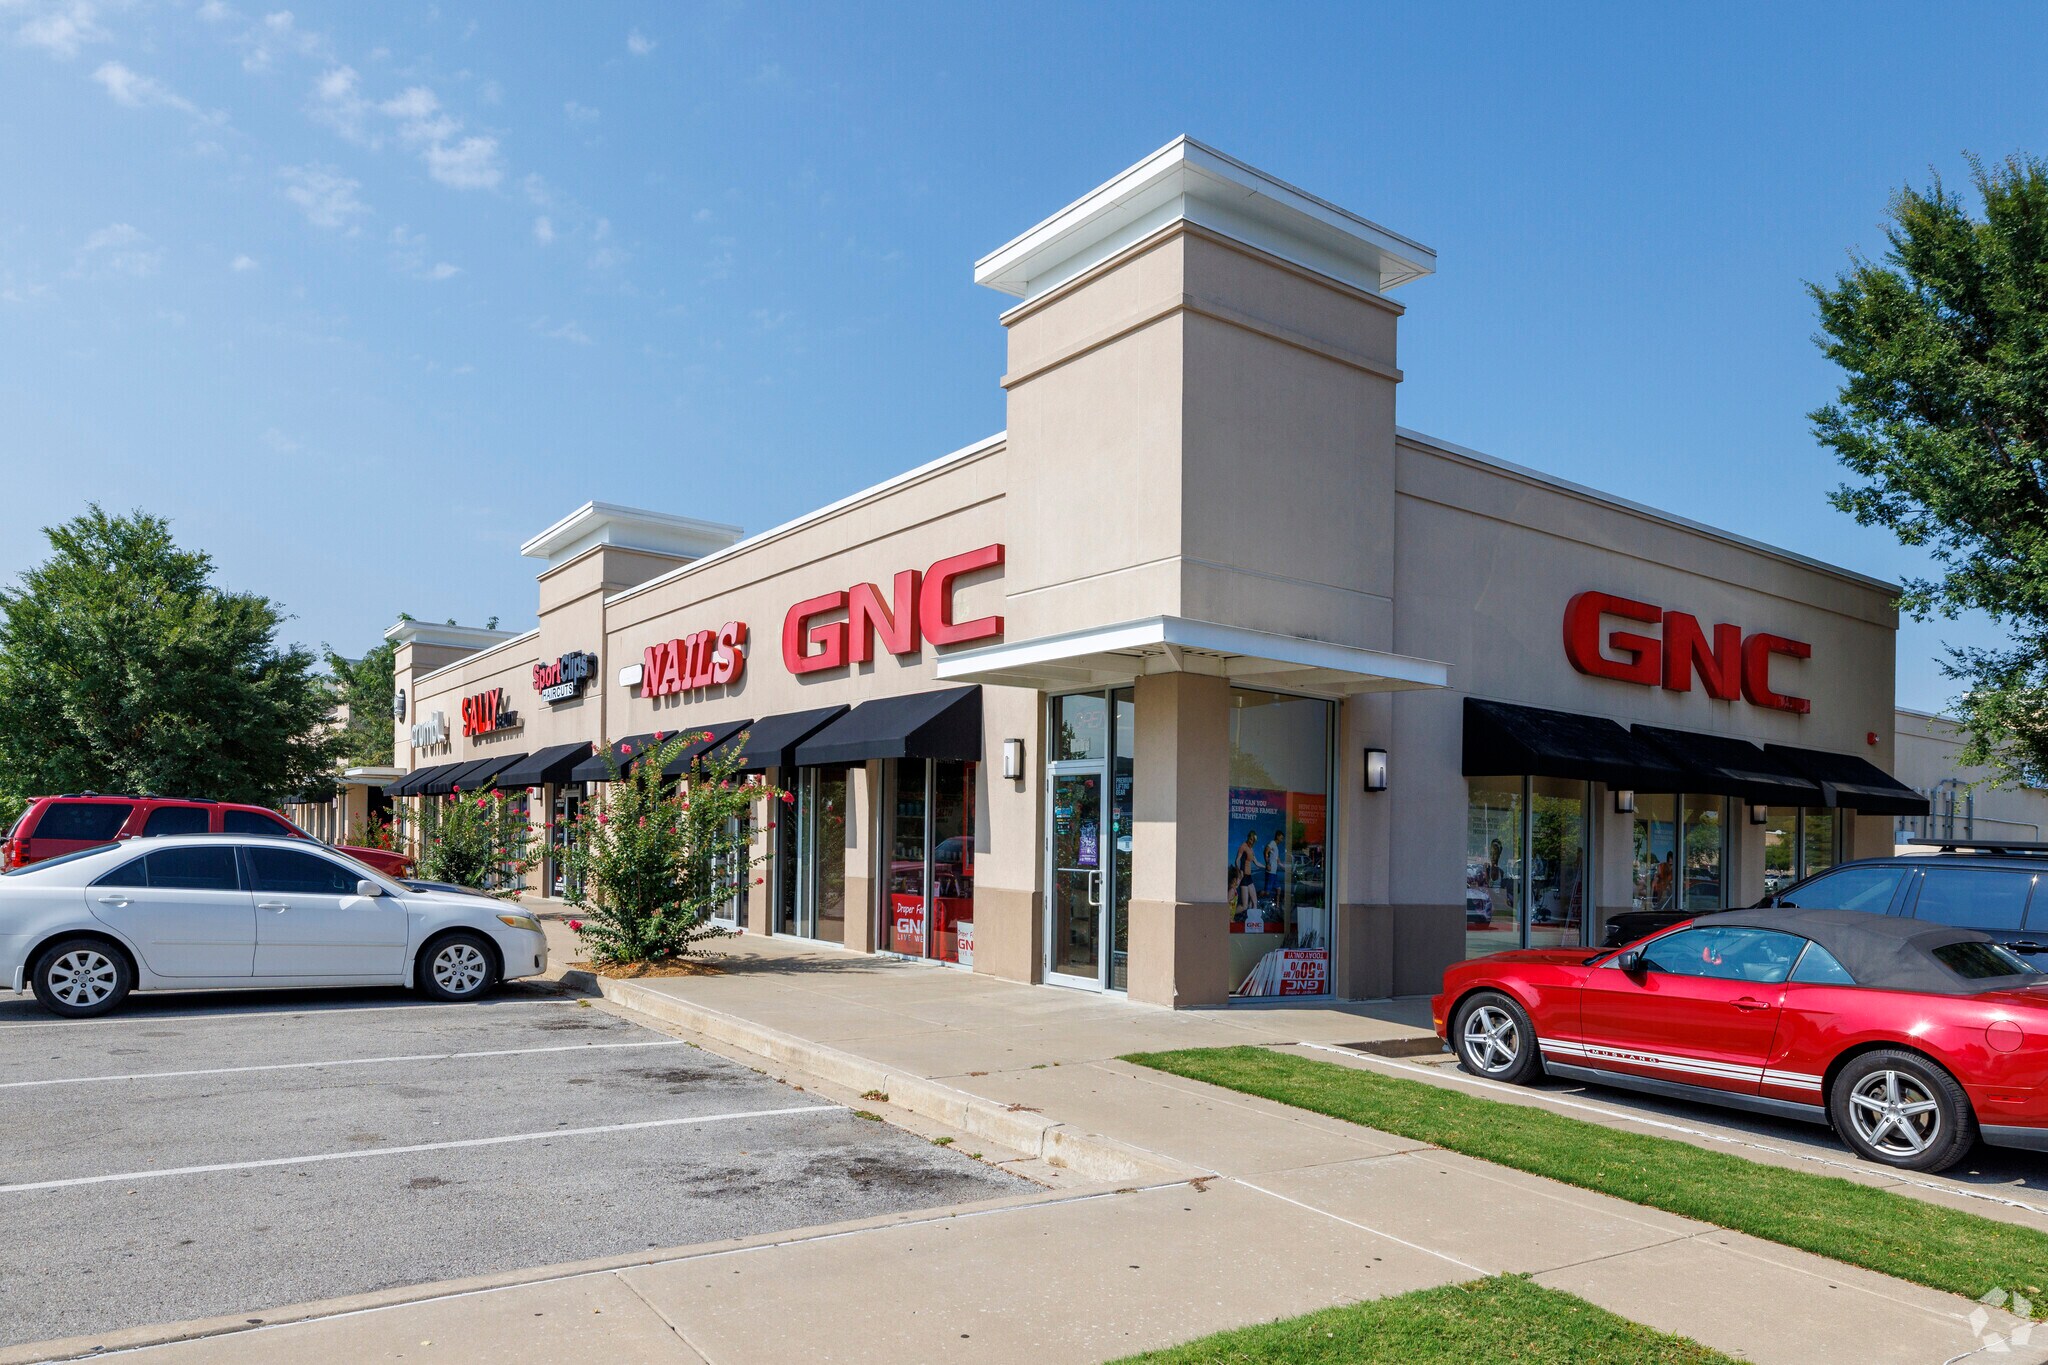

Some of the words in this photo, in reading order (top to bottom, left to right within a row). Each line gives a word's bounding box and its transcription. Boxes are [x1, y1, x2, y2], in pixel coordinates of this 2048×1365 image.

[781, 543, 1005, 674] GNC
[641, 621, 746, 698] NAILS
[1563, 590, 1811, 714] GNC
[542, 683, 573, 700] HAIRCUTS
[462, 688, 502, 737] SALLY
[897, 903, 914, 916] Draper
[958, 938, 974, 951] GN
[1290, 962, 1316, 979] 50%
[1286, 980, 1318, 990] GNC
[1592, 1050, 1656, 1062] MUSTANG
